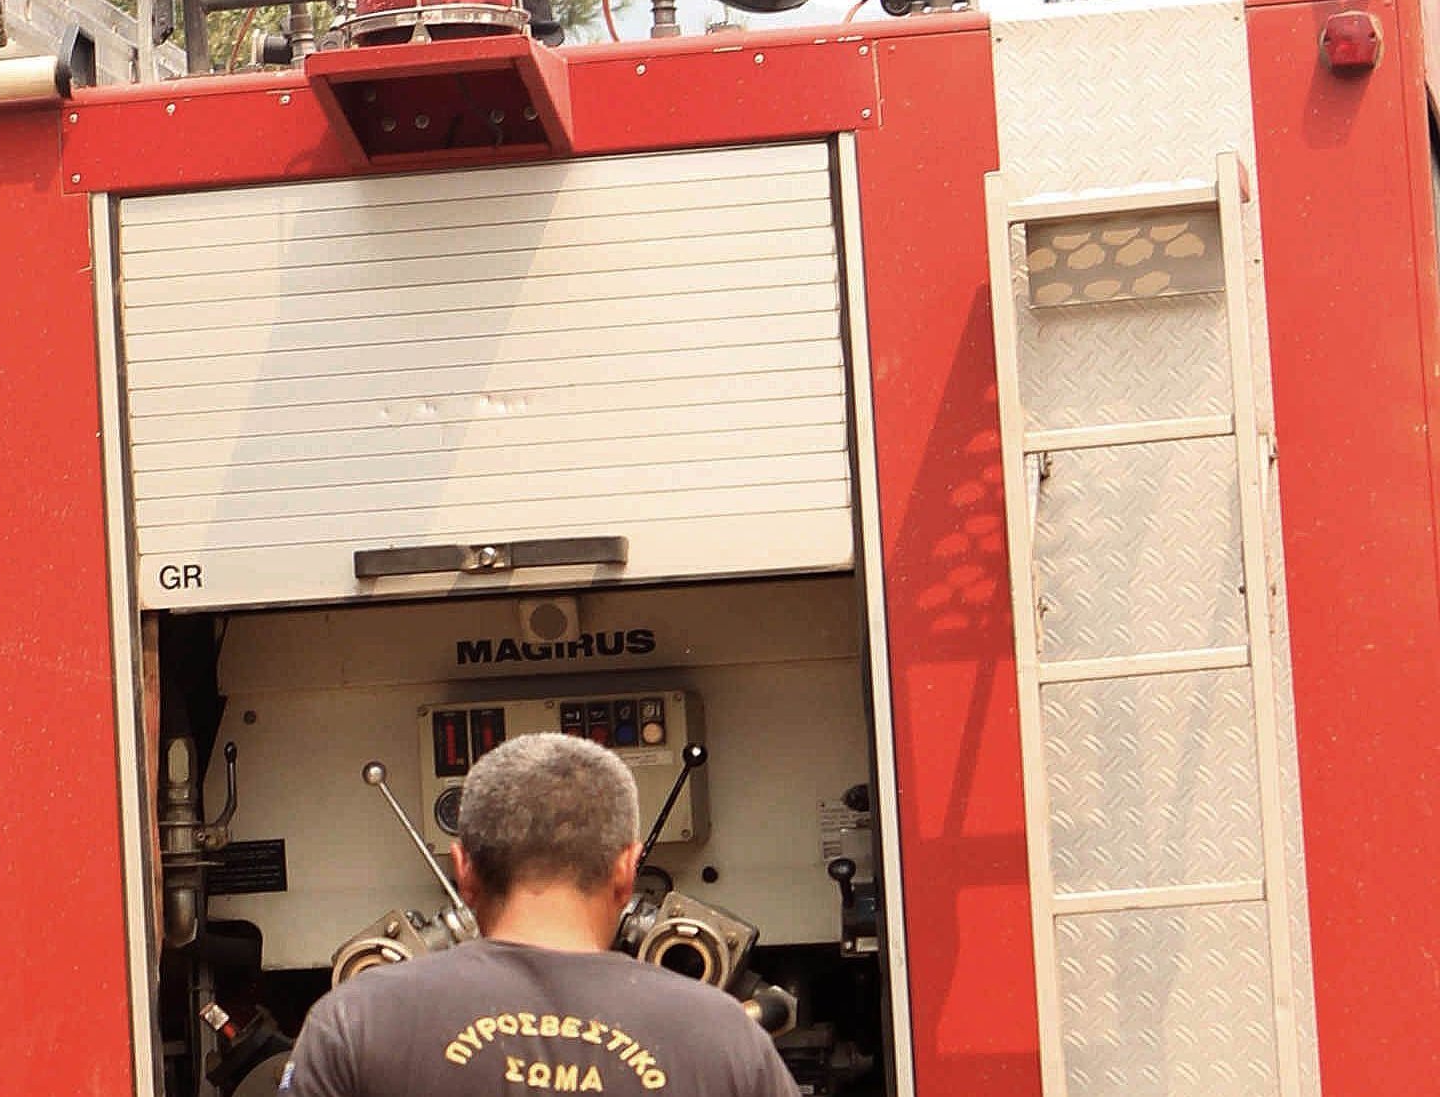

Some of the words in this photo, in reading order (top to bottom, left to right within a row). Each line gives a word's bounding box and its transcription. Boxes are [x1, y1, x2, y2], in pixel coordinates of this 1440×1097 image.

[159, 564, 203, 590] GR
[456, 628, 657, 665] MAGIRUS
[445, 1012, 667, 1090] ΠΥΡΟΣΒΕΣΤΙΚΟ
[504, 1055, 604, 1092] ΣΩΜΑ
